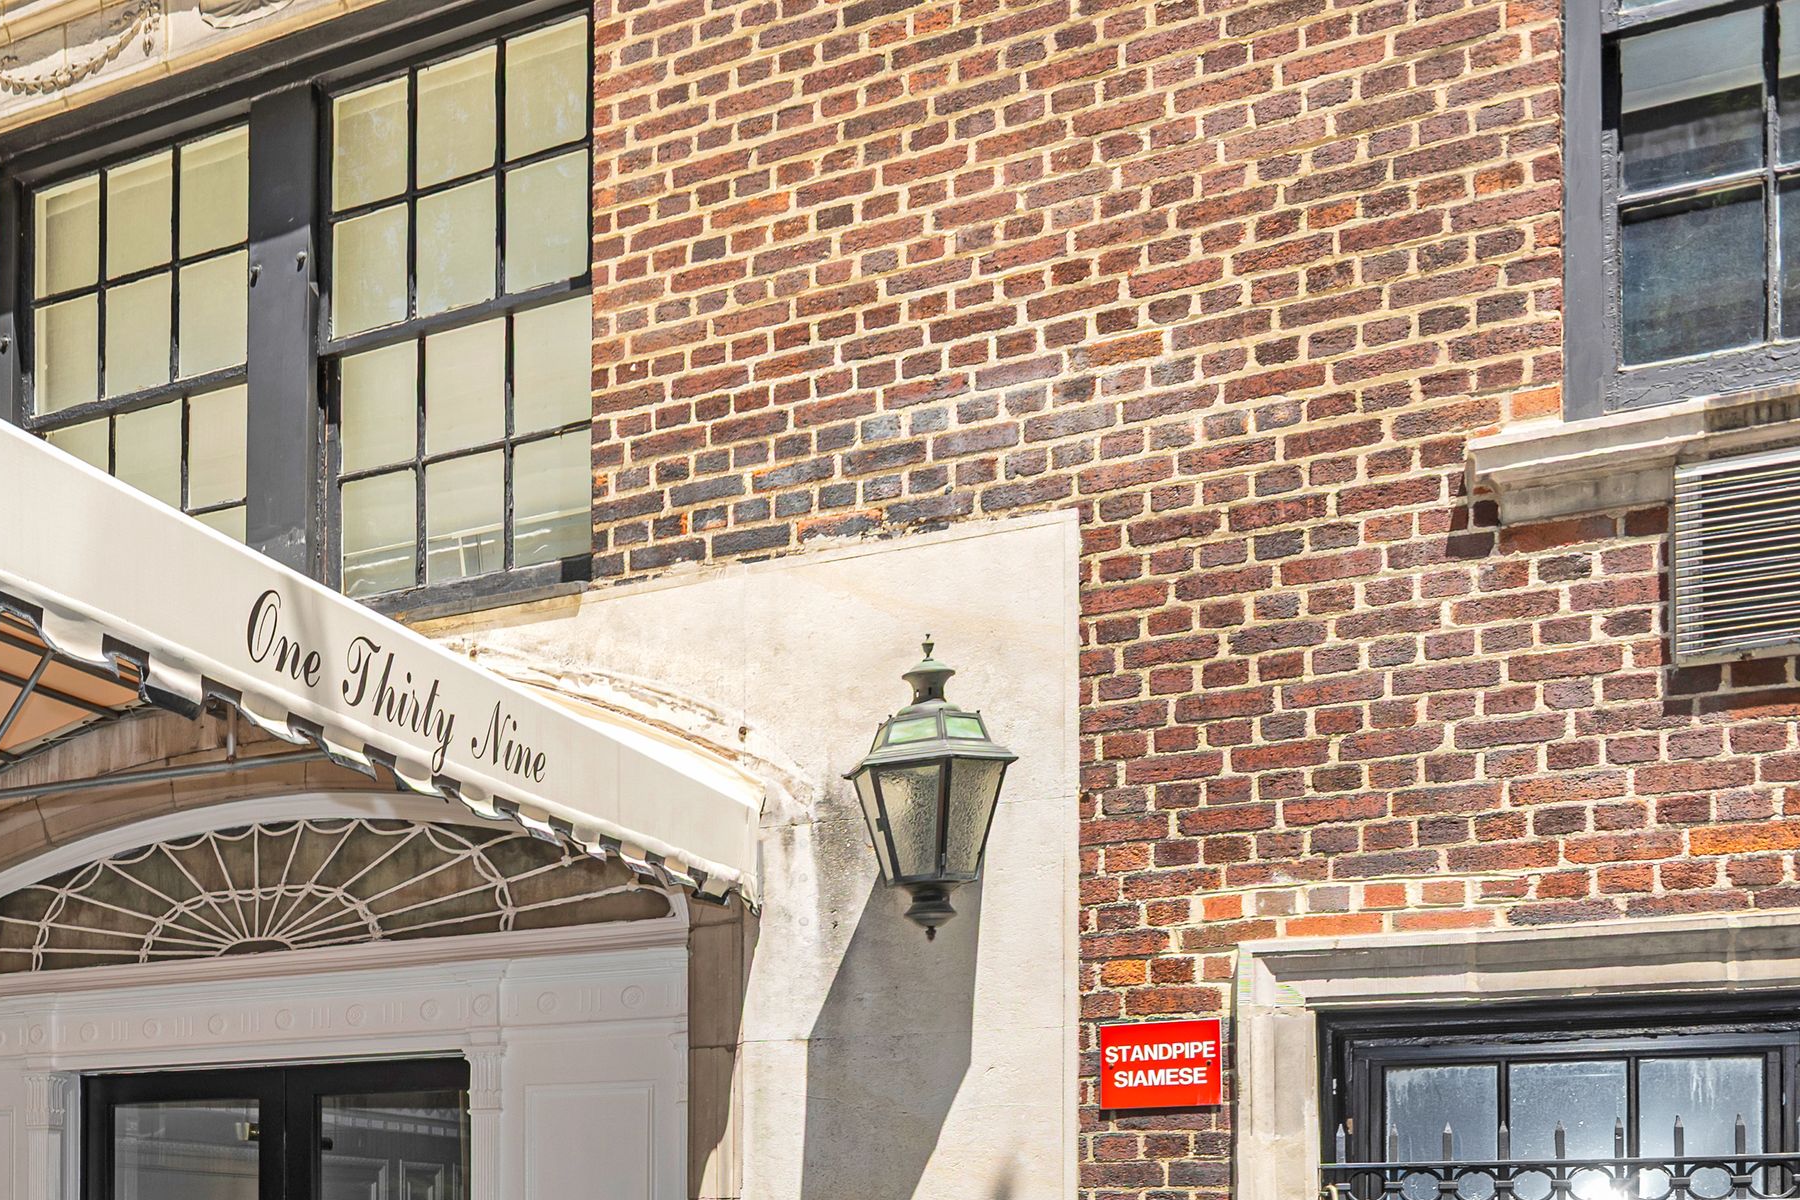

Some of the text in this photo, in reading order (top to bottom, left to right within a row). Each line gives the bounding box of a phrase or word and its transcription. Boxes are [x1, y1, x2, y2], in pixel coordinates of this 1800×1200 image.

[247, 589, 546, 783] One Thirty Nine
[1105, 1040, 1216, 1064] STANDPIPE
[1114, 1067, 1208, 1088] SIAMESE
